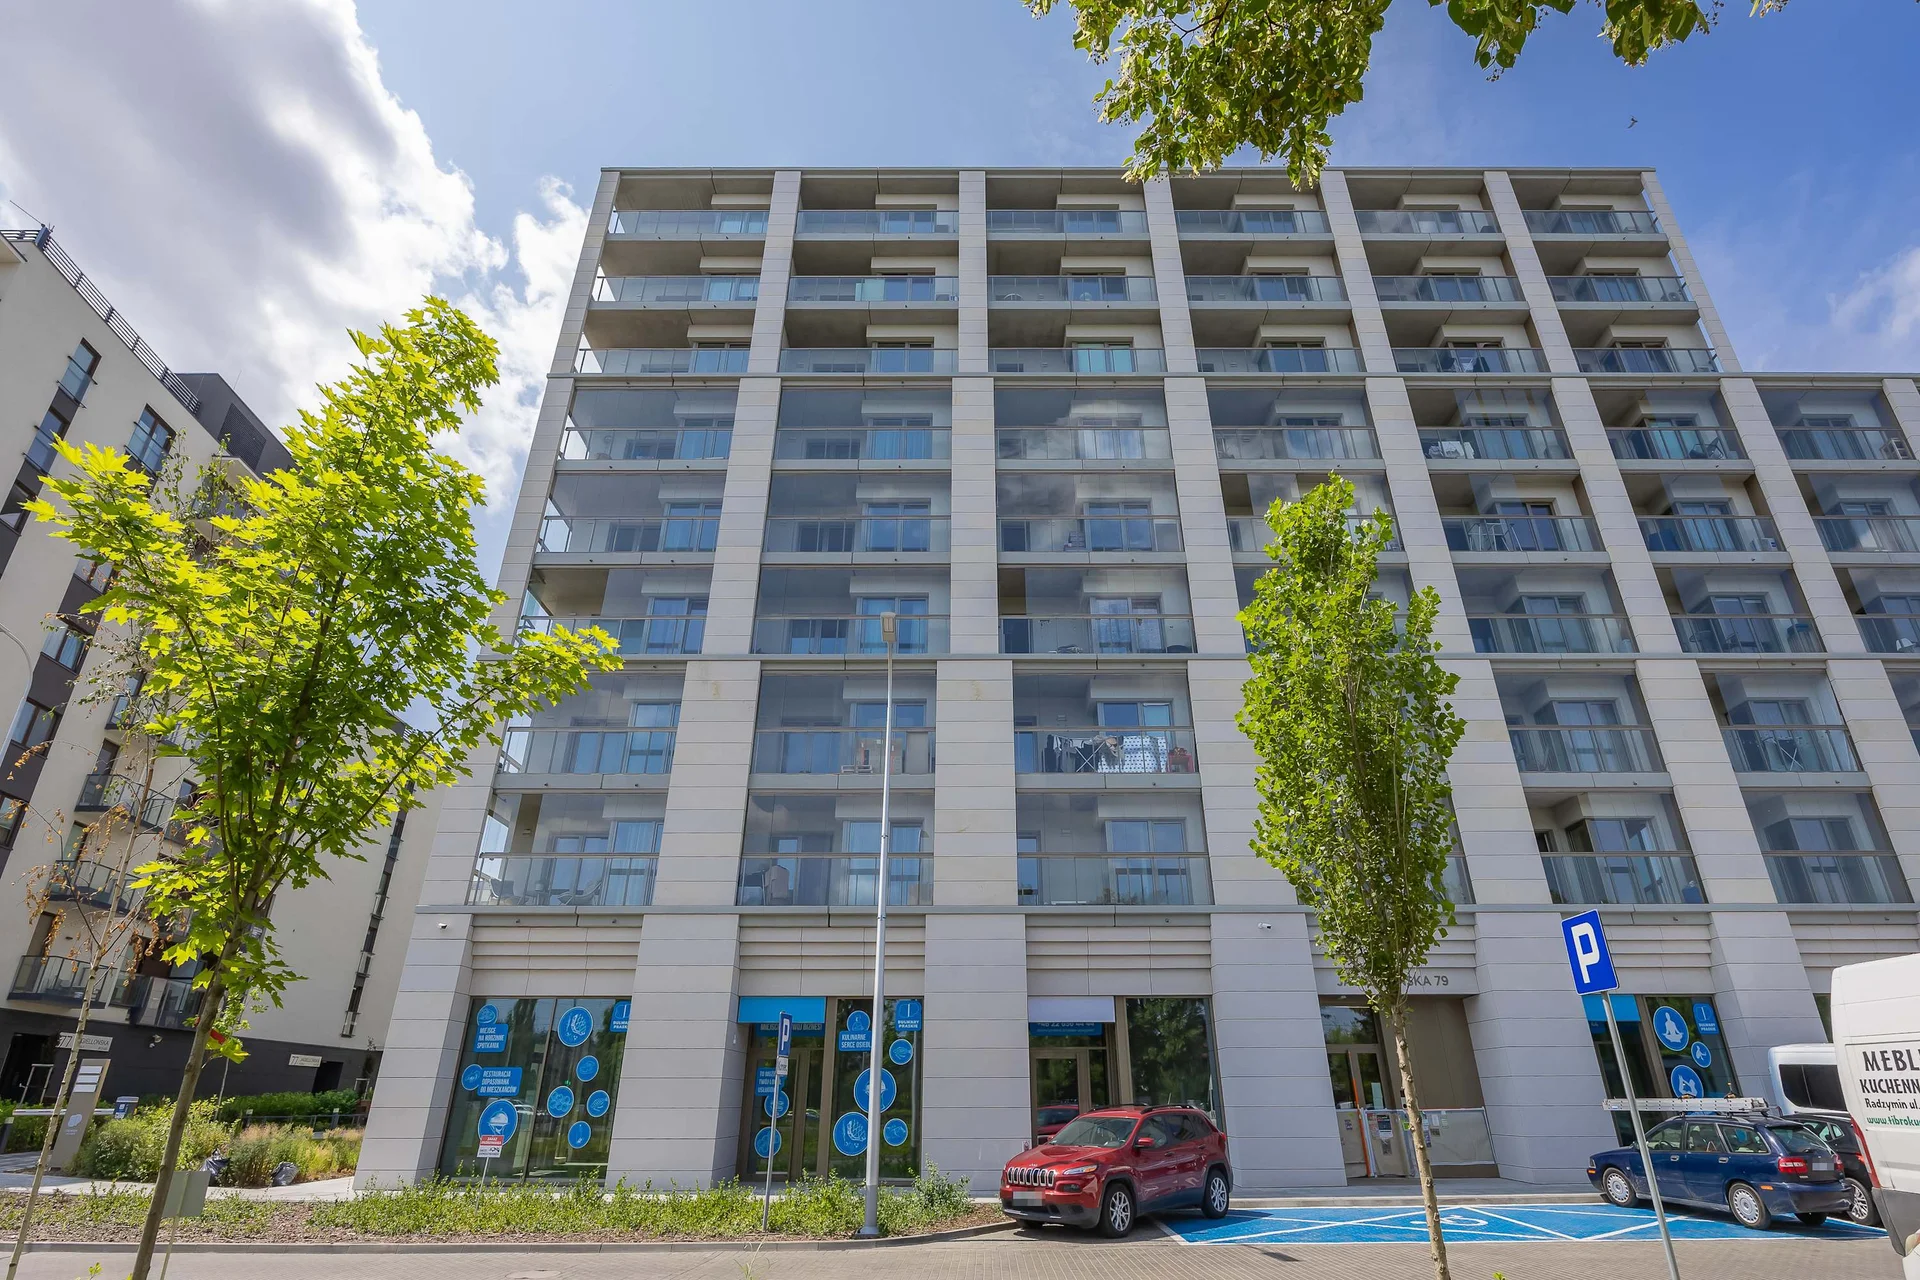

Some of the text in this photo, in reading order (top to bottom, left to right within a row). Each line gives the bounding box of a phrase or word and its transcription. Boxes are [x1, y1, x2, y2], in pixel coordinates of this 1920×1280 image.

[1571, 922, 1600, 984] P
[1434, 975, 1449, 986] 79
[760, 1023, 780, 1031] MIEJSC
[781, 1018, 790, 1051] P
[841, 1033, 866, 1041] KULINARNE
[841, 1041, 872, 1049] SERCE OSIEDL
[1863, 1049, 1920, 1072] MEBL
[483, 1070, 511, 1078] RESTAURACJA
[481, 1078, 510, 1086] DOPASOWANA
[480, 1086, 487, 1094] DO
[1865, 1098, 1908, 1111] Radzymin
